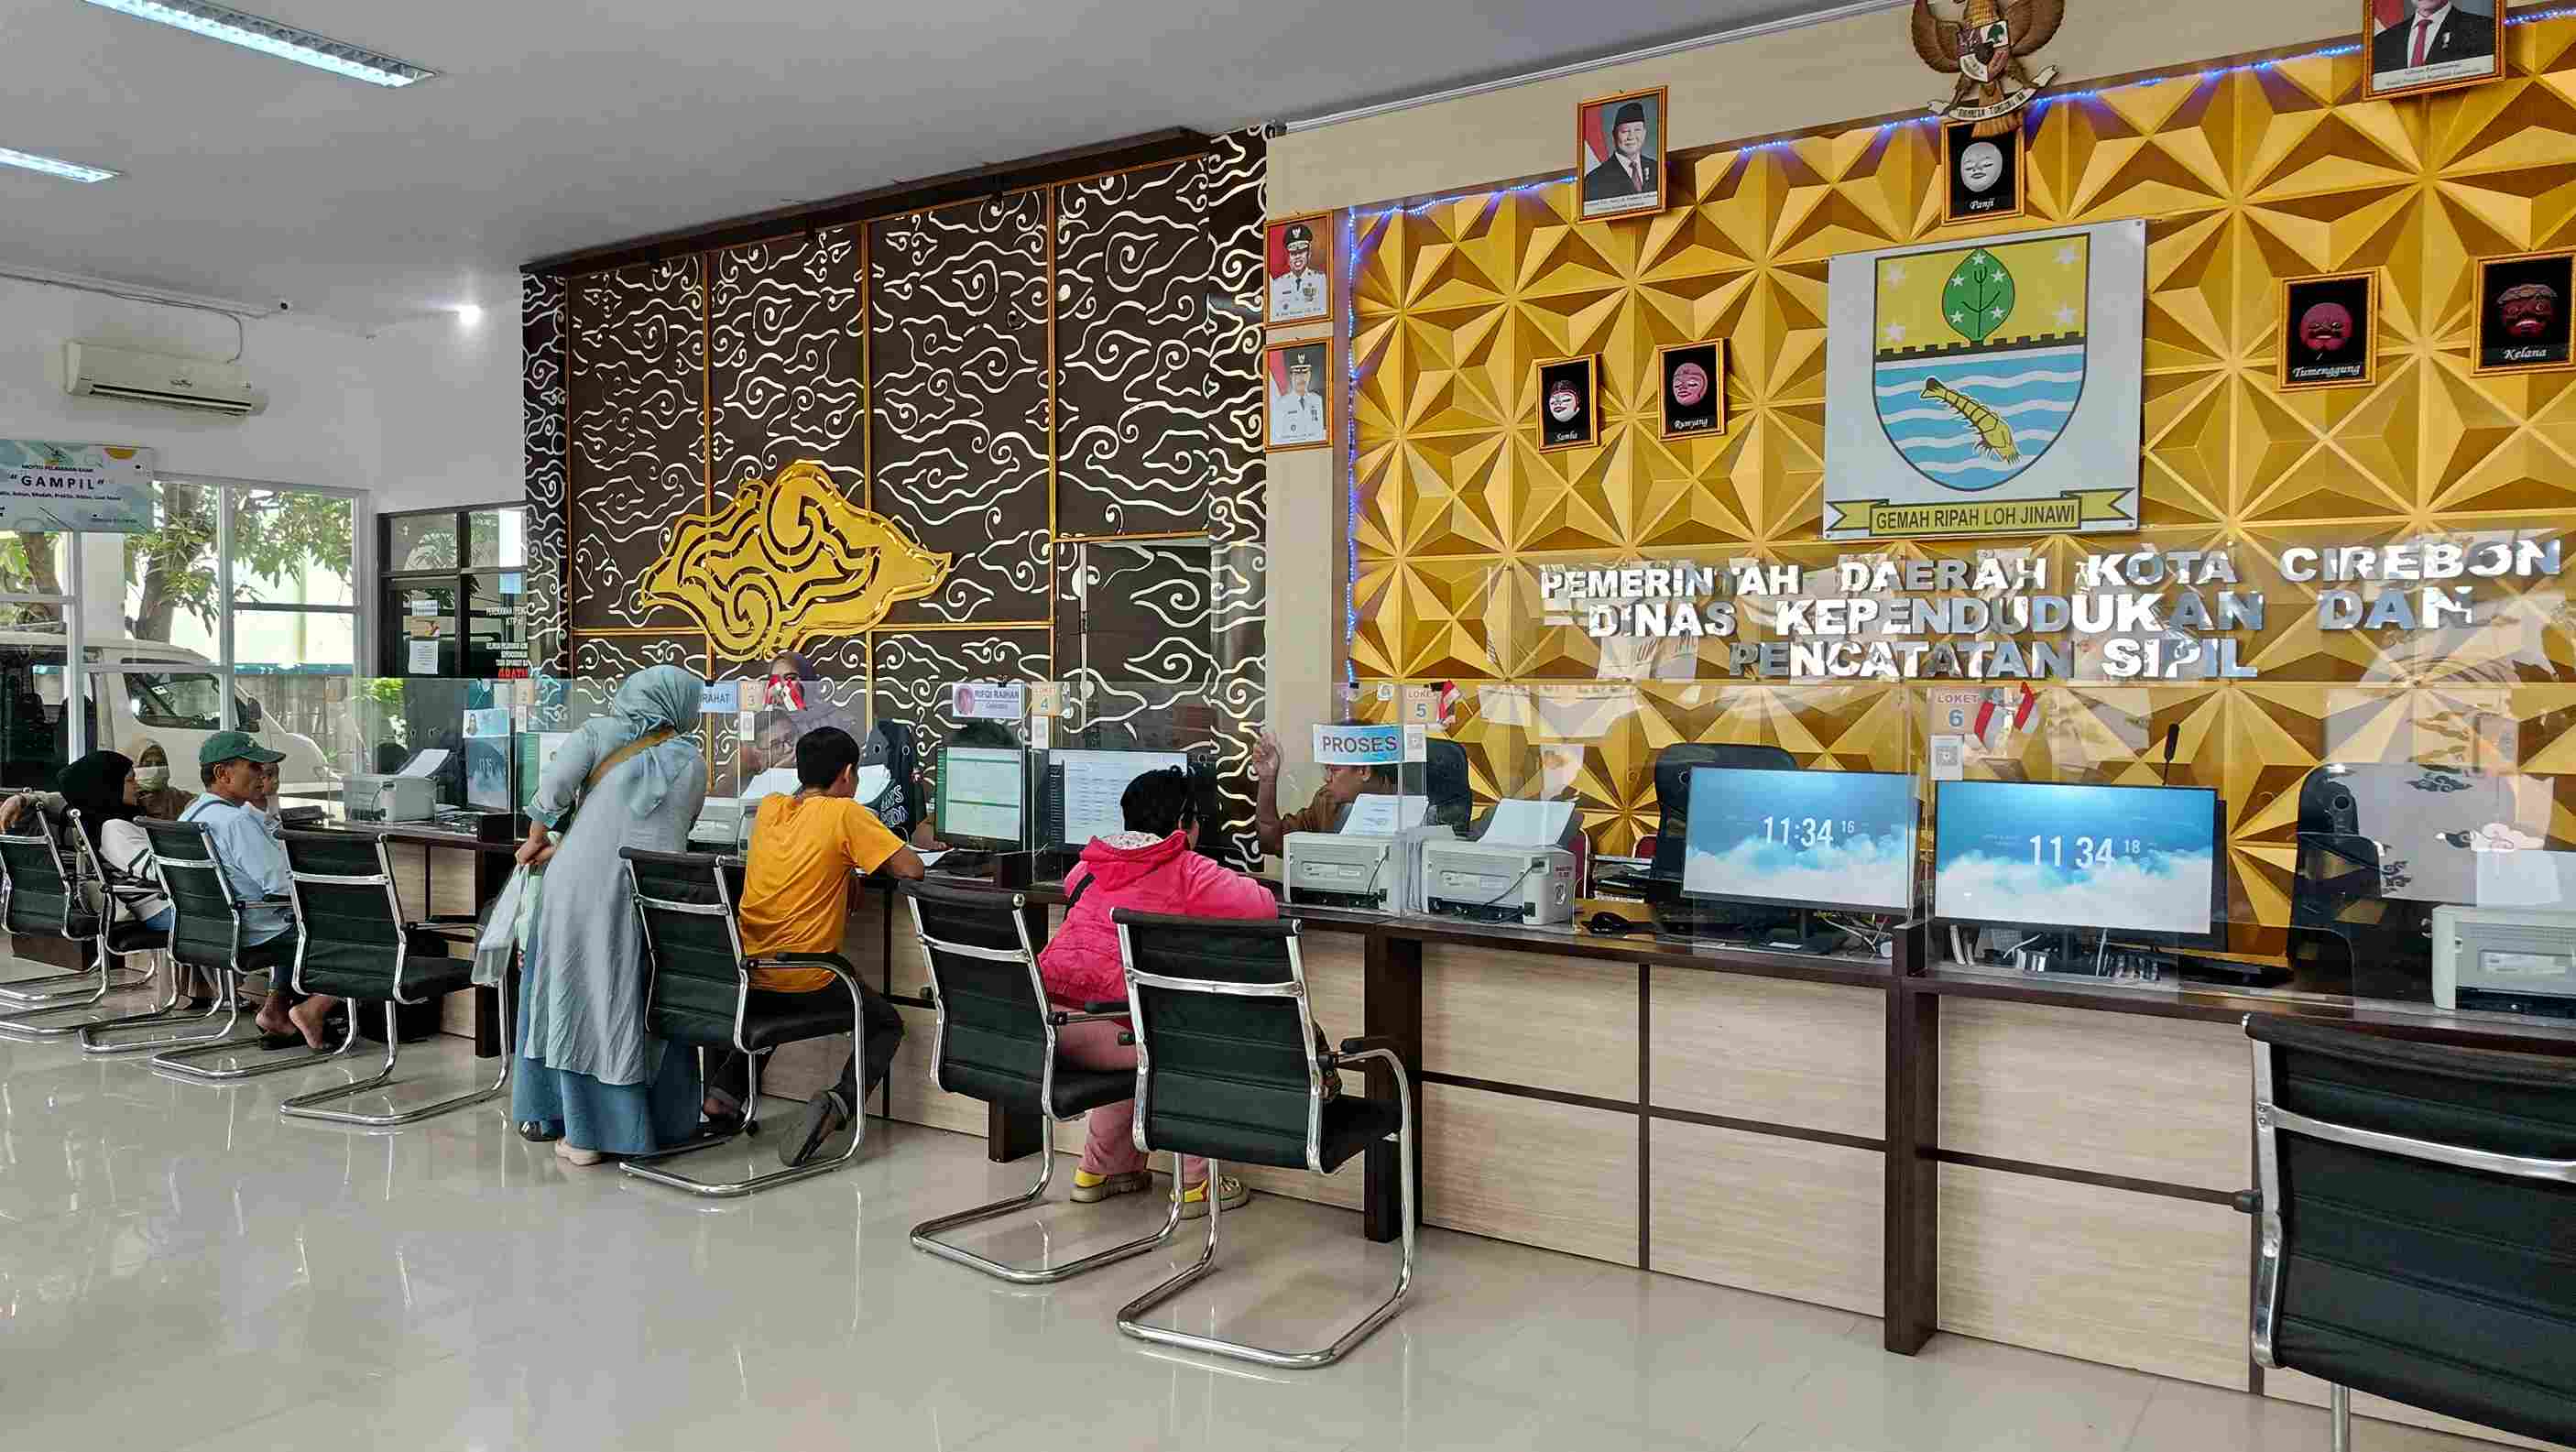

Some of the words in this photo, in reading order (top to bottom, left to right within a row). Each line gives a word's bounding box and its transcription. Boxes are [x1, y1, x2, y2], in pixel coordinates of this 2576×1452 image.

[2503, 346, 2547, 360] Kelana
[2292, 364, 2361, 377] Tumenggung
[1876, 509, 1930, 529] GEMAH
[1934, 508, 1979, 528] RIPAH
[1983, 507, 2016, 526] LOH
[2020, 505, 2075, 525] JINAWI
[1840, 557, 2047, 591] DAERAH
[2088, 551, 2238, 586] KOTA
[2279, 539, 2561, 582] CIREBON
[1589, 600, 1738, 638] DINAS
[1776, 591, 2264, 636] KEPENDUDUKAN
[2318, 586, 2472, 630] DAN
[1730, 640, 2071, 678] PENCATATAN
[2102, 639, 2258, 678] SIPIL
[703, 692, 730, 704] RAHAT
[1937, 694, 1979, 704] LOKET
[1415, 704, 1427, 717] 5
[1948, 709, 1963, 727] 6
[1322, 734, 1398, 754] PROSES
[1763, 816, 1833, 849] 11:34
[1841, 820, 1855, 834] 16
[2124, 839, 2141, 854] 18
